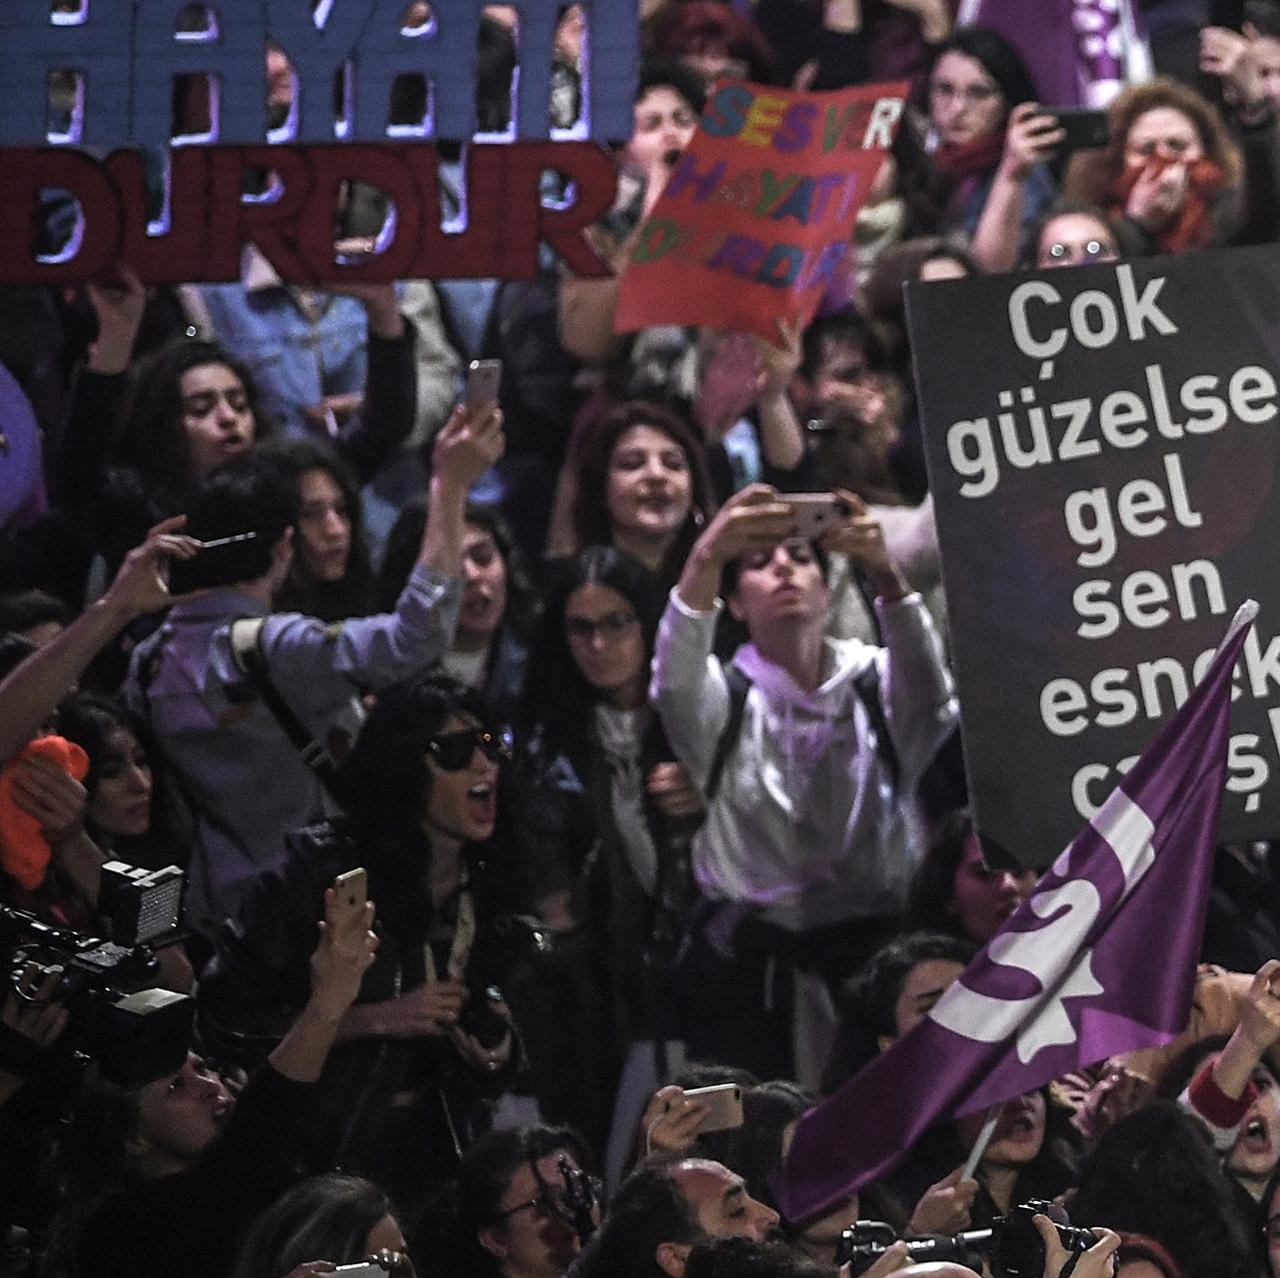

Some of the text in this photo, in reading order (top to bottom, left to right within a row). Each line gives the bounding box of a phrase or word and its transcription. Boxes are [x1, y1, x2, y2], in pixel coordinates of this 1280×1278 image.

[701, 86, 818, 153] SES
[1007, 263, 1178, 380] Çok
[946, 364, 1279, 498] güzelse
[1064, 453, 1203, 567] gel
[1072, 558, 1227, 640] sen
